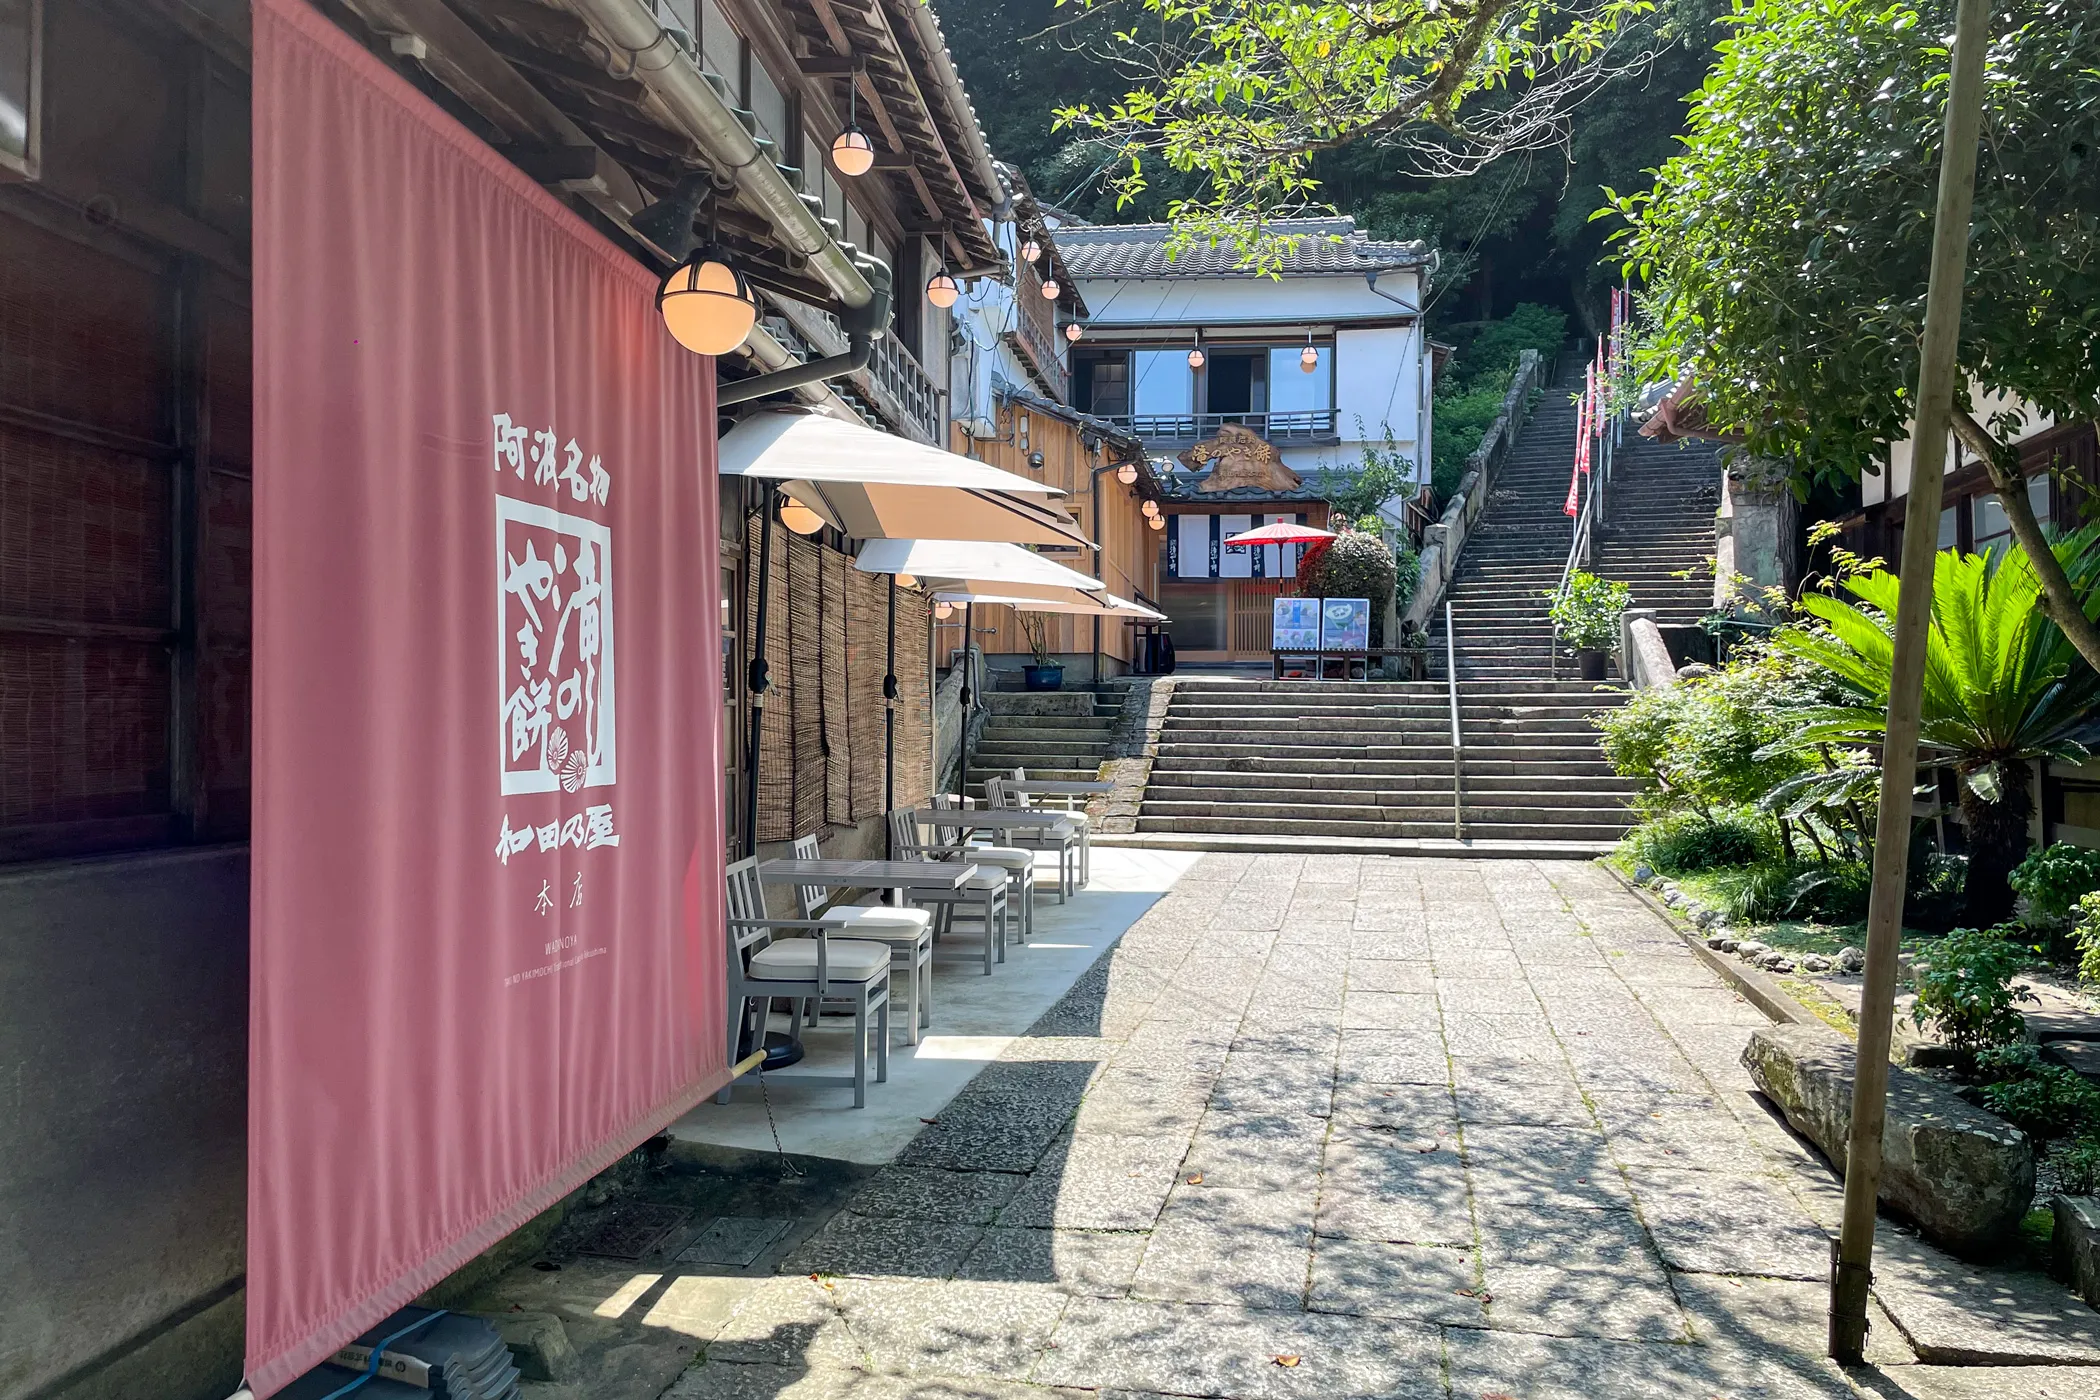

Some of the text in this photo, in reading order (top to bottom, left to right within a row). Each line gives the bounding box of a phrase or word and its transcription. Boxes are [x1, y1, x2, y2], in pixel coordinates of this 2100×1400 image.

[493, 412, 611, 507] 阿波名物
[1192, 444, 1271, 465] 滝のやき餅
[533, 871, 583, 916] 本店
